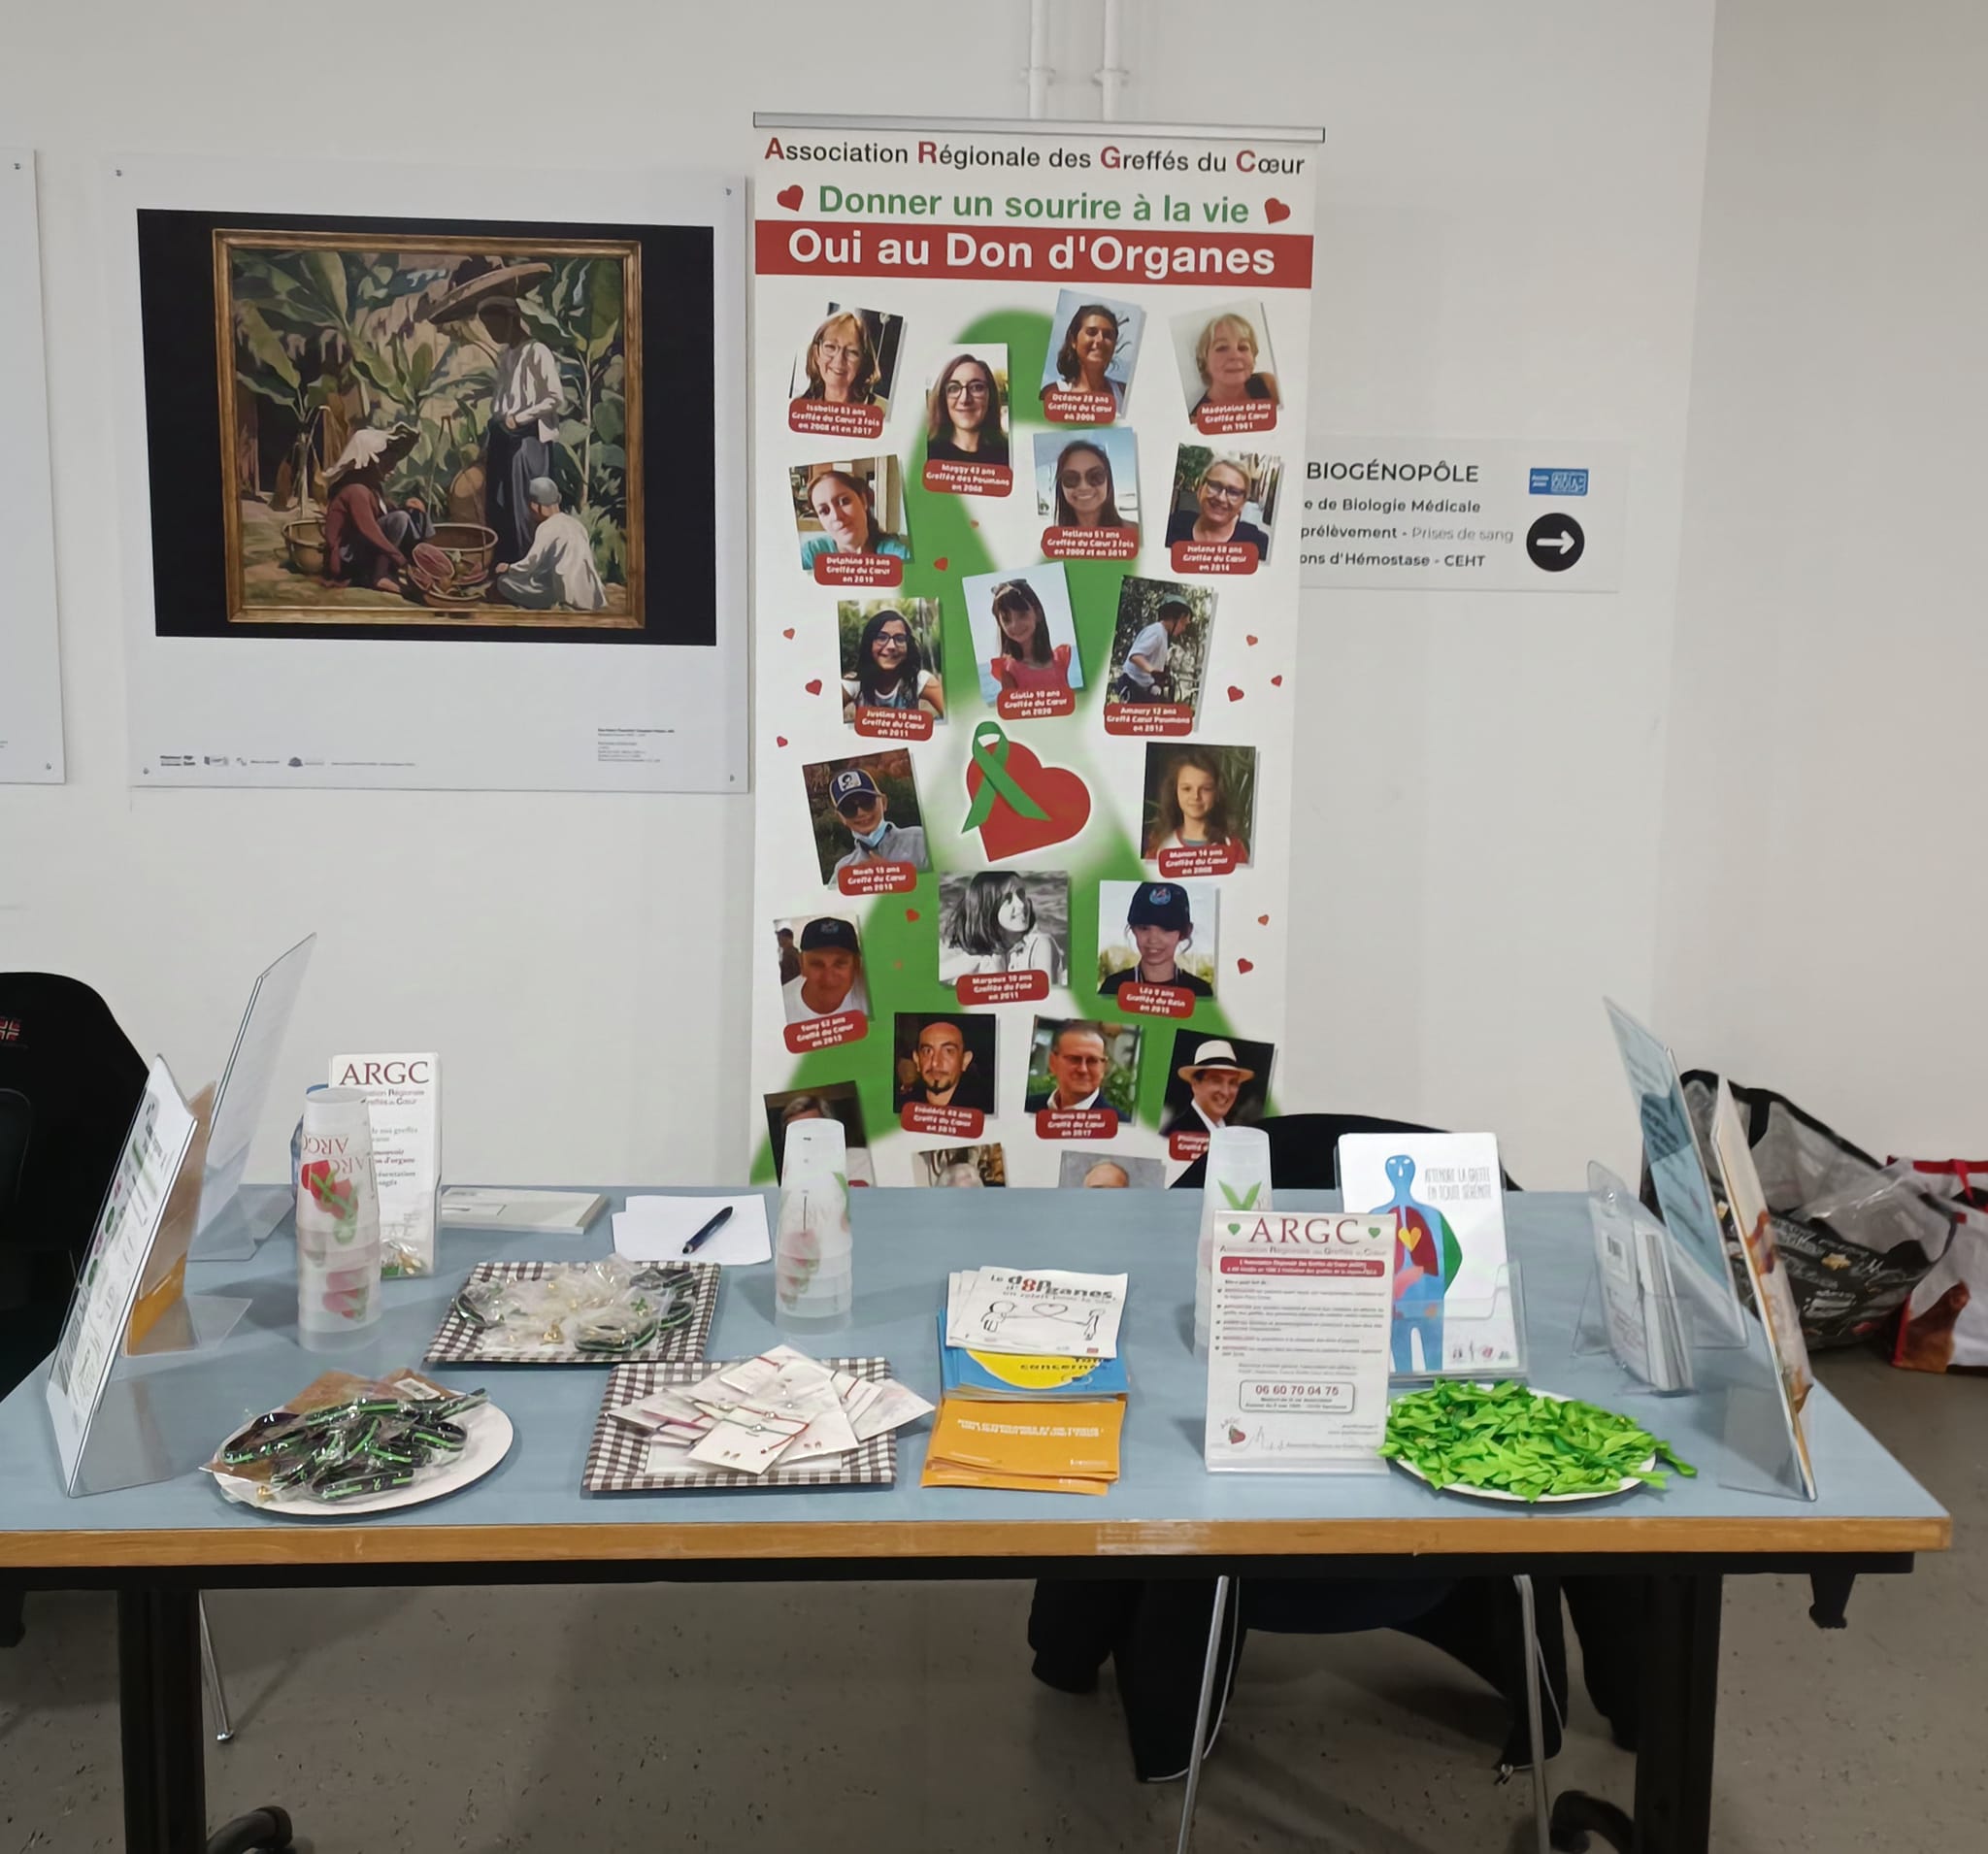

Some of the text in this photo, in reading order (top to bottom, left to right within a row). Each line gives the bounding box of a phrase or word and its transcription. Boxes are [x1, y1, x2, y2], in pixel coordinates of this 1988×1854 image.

[764, 137, 1306, 176] Association Régionale des Greffés du Cœur
[818, 184, 1250, 224] Donner un sourire à la vie
[788, 227, 1276, 281] Oui au Don d'Organes
[806, 403, 866, 416] Isabelle ans
[1078, 404, 1089, 413] du
[791, 412, 821, 421] Greffée
[822, 414, 834, 422] du
[1235, 413, 1245, 421] du
[830, 423, 840, 432] et
[1221, 422, 1233, 431] en
[981, 467, 996, 476] ans
[1307, 458, 1480, 483] BIOGÉNOPÔLE
[925, 471, 955, 481] Greffée
[956, 473, 972, 482] des
[1318, 497, 1338, 511] de
[1342, 497, 1406, 513] Biologie
[1411, 499, 1480, 513] Médicale
[1106, 530, 1120, 539] ans
[1301, 524, 1514, 544] prélèvement Prises de sang
[1046, 538, 1077, 546] Greffée
[1077, 539, 1088, 547] du
[826, 556, 891, 567] Delphine ans
[1182, 553, 1212, 563] Greffée
[1213, 554, 1224, 563] du
[1329, 551, 1430, 567] d'Hémostase
[1444, 554, 1486, 568] CEHT
[826, 565, 855, 575] Greffée
[856, 566, 867, 575] du
[1004, 699, 1034, 709] Greffée
[1034, 699, 1044, 708] du
[861, 717, 891, 728] Greffée
[892, 720, 904, 729] du
[847, 875, 872, 884] Greffé
[1003, 982, 1014, 991] du
[1155, 997, 1167, 1006] du
[339, 1061, 430, 1085] ARGC
[1248, 1216, 1360, 1244] ARGC
[1255, 1384, 1270, 1396] 06
[1273, 1385, 1287, 1396] 60
[1290, 1385, 1305, 1396] 70
[1308, 1385, 1321, 1397] 04
